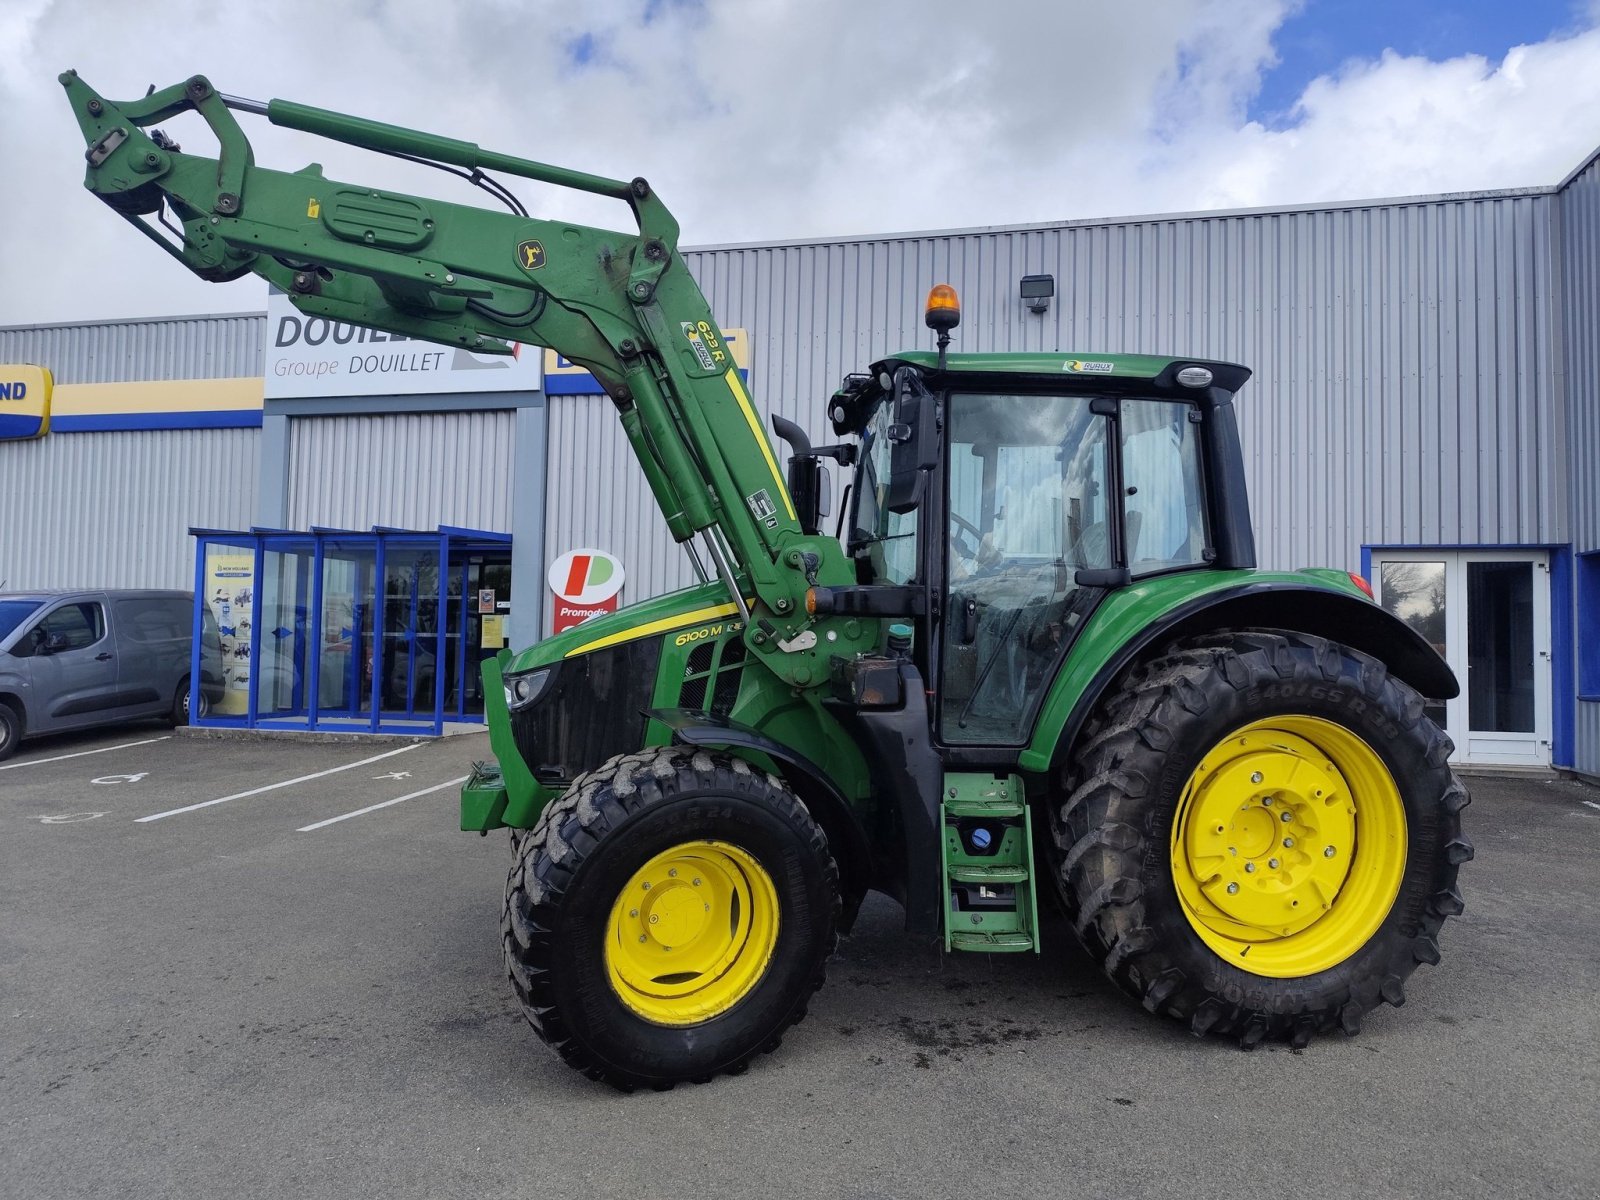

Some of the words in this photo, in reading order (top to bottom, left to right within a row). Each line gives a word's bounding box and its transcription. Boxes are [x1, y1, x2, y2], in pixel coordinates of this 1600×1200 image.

[697, 320, 719, 348] 623
[711, 350, 726, 362] R
[274, 358, 339, 379] Groupe
[349, 352, 445, 374] DOUILLET
[675, 628, 709, 646] 6100
[710, 624, 723, 637] M
